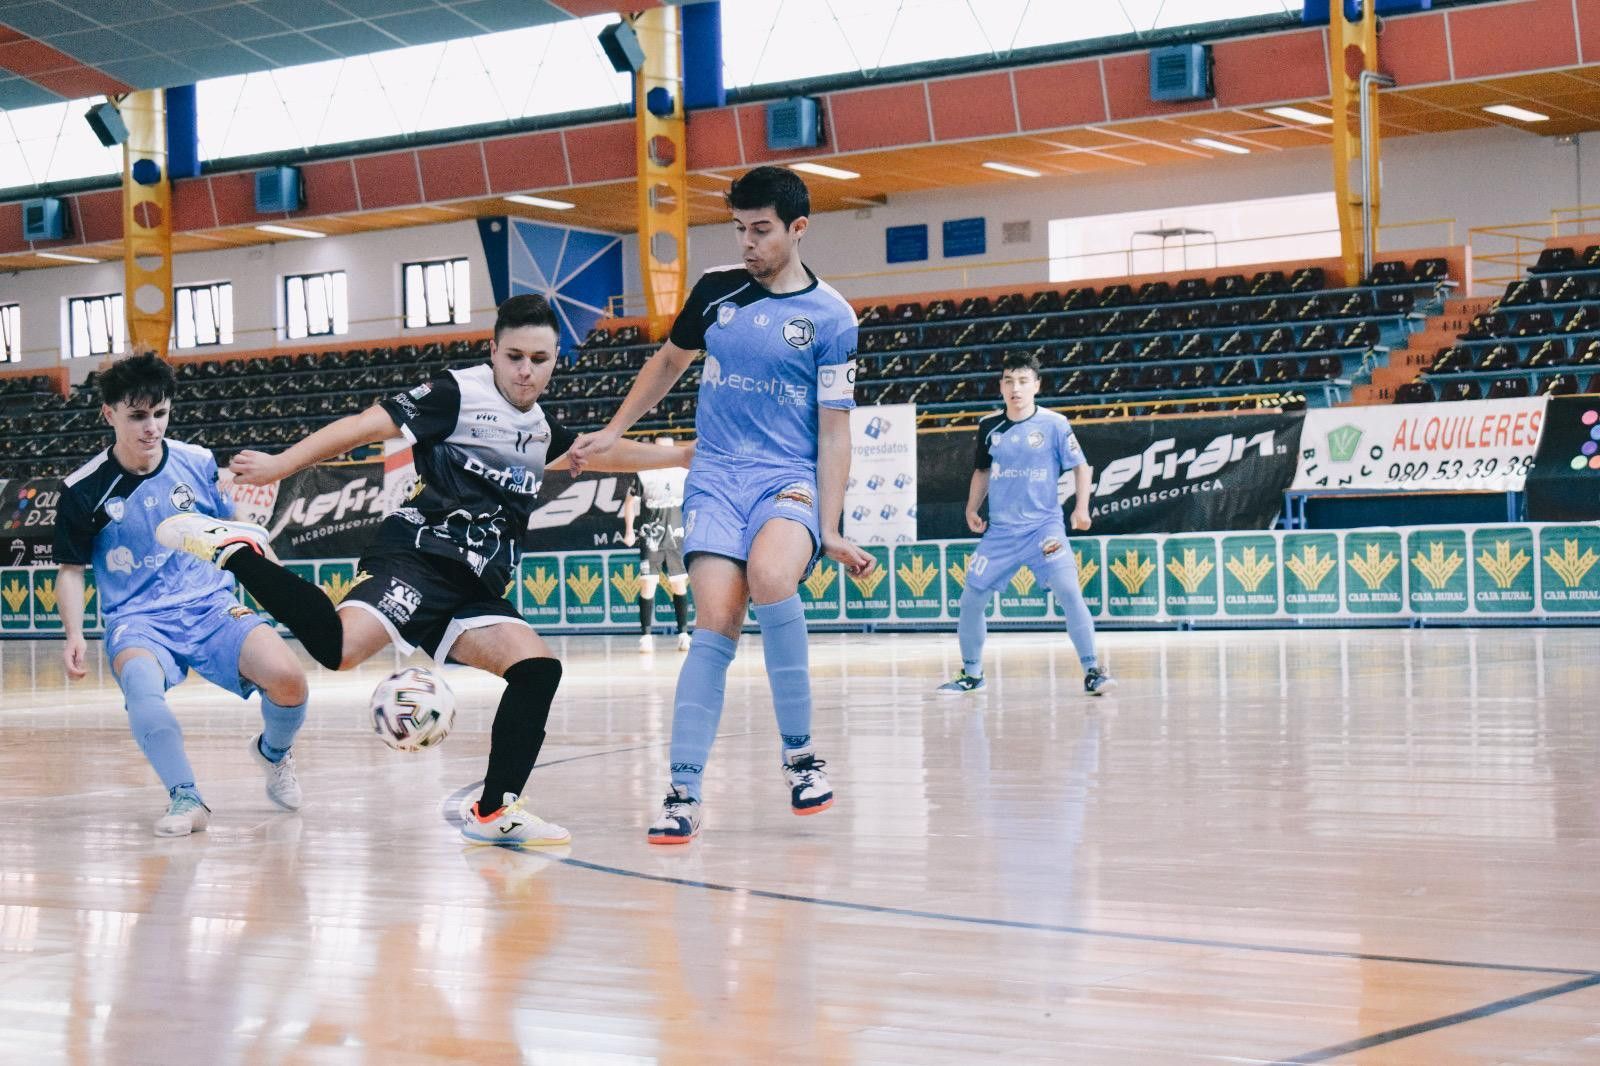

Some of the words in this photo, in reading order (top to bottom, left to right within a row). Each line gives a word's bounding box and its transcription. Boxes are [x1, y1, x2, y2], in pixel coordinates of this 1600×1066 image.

[1392, 410, 1542, 452] ALQUILERES
[852, 441, 909, 457] rogesdatos
[1385, 461, 1429, 483] 980
[1432, 459, 1464, 480] 53
[1466, 457, 1498, 479] 39
[1502, 455, 1534, 477] 38
[1091, 478, 1224, 518] ACRODISCOTECA
[290, 515, 386, 547] MACRODISCOTEC
